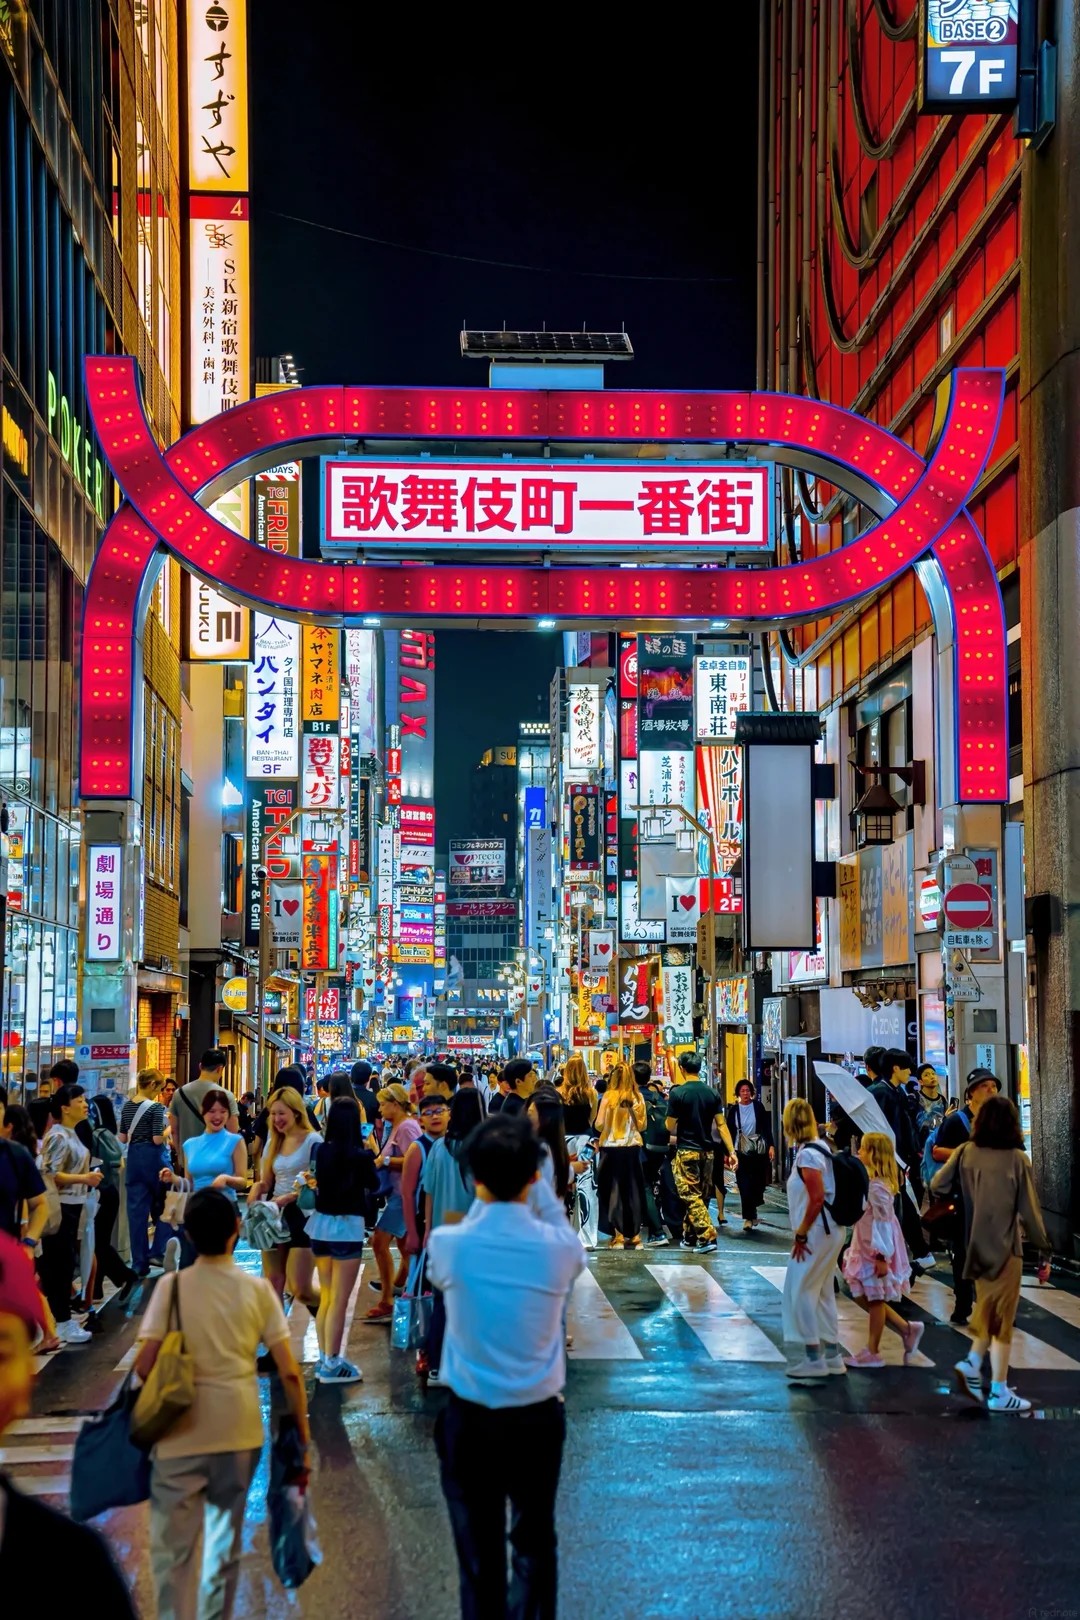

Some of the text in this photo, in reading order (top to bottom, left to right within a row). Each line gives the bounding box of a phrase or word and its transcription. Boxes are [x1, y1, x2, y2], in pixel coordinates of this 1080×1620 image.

[940, 51, 1005, 95] 7F
[201, 41, 237, 179] すずや
[230, 200, 243, 216] 4
[267, 486, 289, 499] TGI
[341, 474, 754, 536] 歌舞伎町一番街
[257, 494, 266, 542] American
[699, 660, 747, 671] 全卓全自動
[309, 643, 323, 716] ヤマネ肉店
[254, 655, 280, 744] バンタイ
[283, 656, 294, 738] タイ国料理専門店
[709, 673, 728, 736] 東南荘
[312, 722, 331, 732] B1F
[699, 728, 708, 736] 3F
[262, 764, 282, 774] 3F
[264, 789, 292, 804] TGI
[721, 749, 740, 840] ハイボール
[251, 799, 262, 862] American
[95, 854, 115, 951] 劇場通り
[251, 889, 261, 899] &
[672, 895, 680, 912] I
[720, 898, 741, 911] 2F
[251, 903, 261, 931] Grill
[274, 899, 282, 917] I
[593, 944, 598, 955] I
[947, 935, 989, 945] 自転車を除く
[672, 971, 691, 1027] お好み焼き
